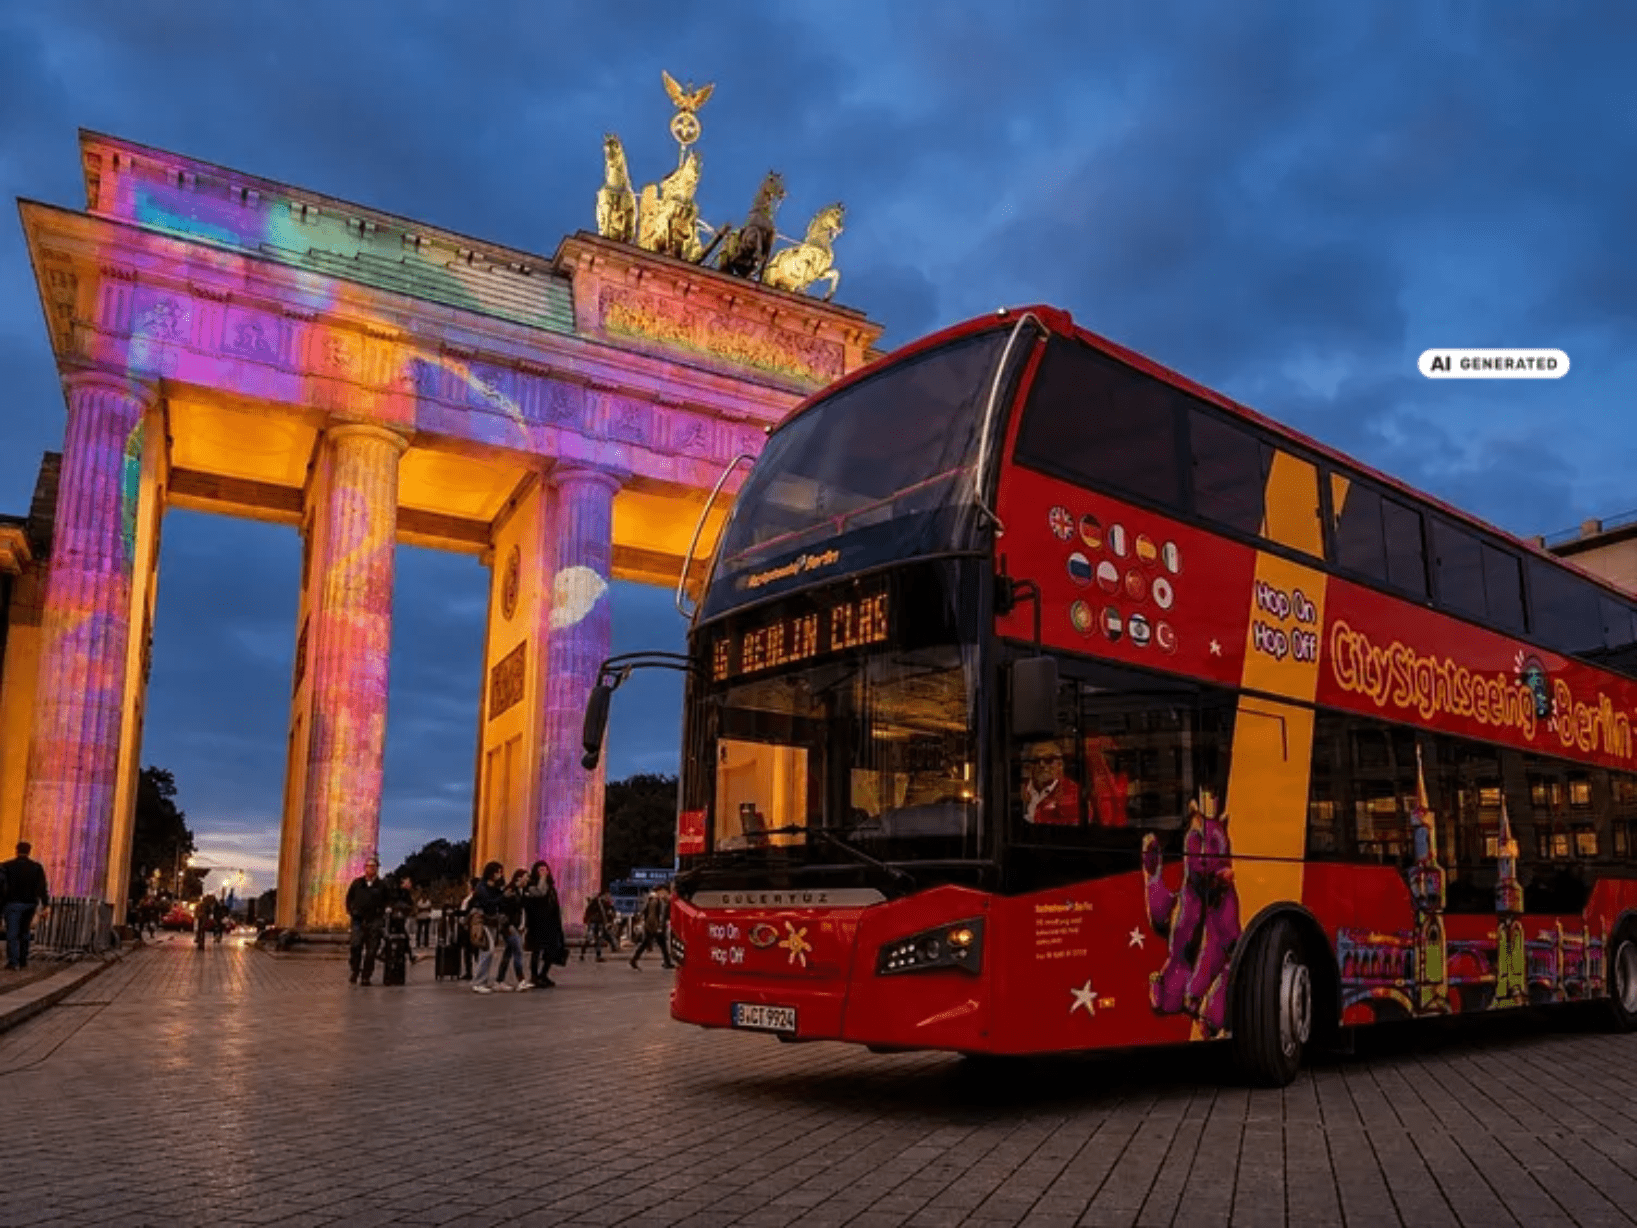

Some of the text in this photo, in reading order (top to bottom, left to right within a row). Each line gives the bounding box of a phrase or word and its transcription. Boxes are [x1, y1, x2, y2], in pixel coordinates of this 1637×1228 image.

[1256, 580, 1317, 625] Hop On
[742, 613, 817, 674] BERLIN
[1253, 620, 1316, 664] Hop Off
[1330, 620, 1633, 759] CitySightseeing Berlin
